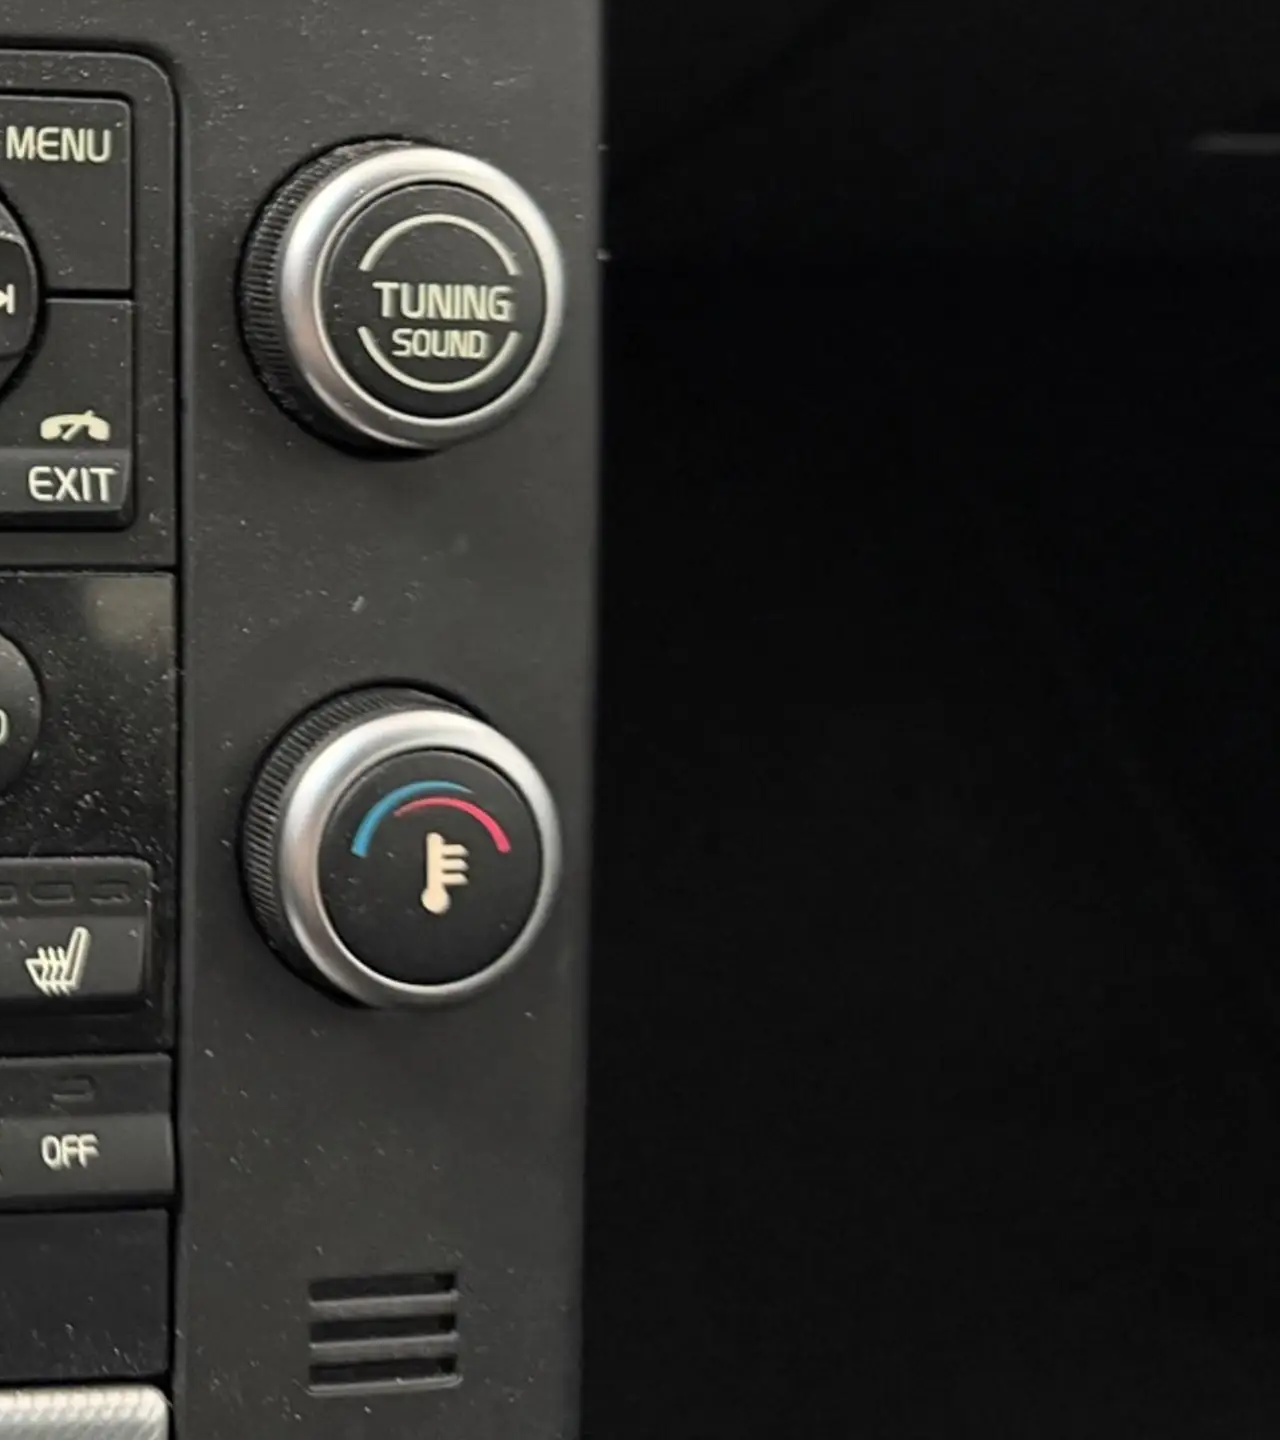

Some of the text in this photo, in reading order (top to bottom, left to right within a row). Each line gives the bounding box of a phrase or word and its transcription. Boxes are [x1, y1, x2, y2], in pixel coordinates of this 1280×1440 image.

[6, 125, 111, 163] MENU
[372, 281, 513, 322] TUNING
[392, 328, 489, 359] SOUND
[28, 466, 116, 502] EXIT
[41, 1134, 98, 1168] OFF
